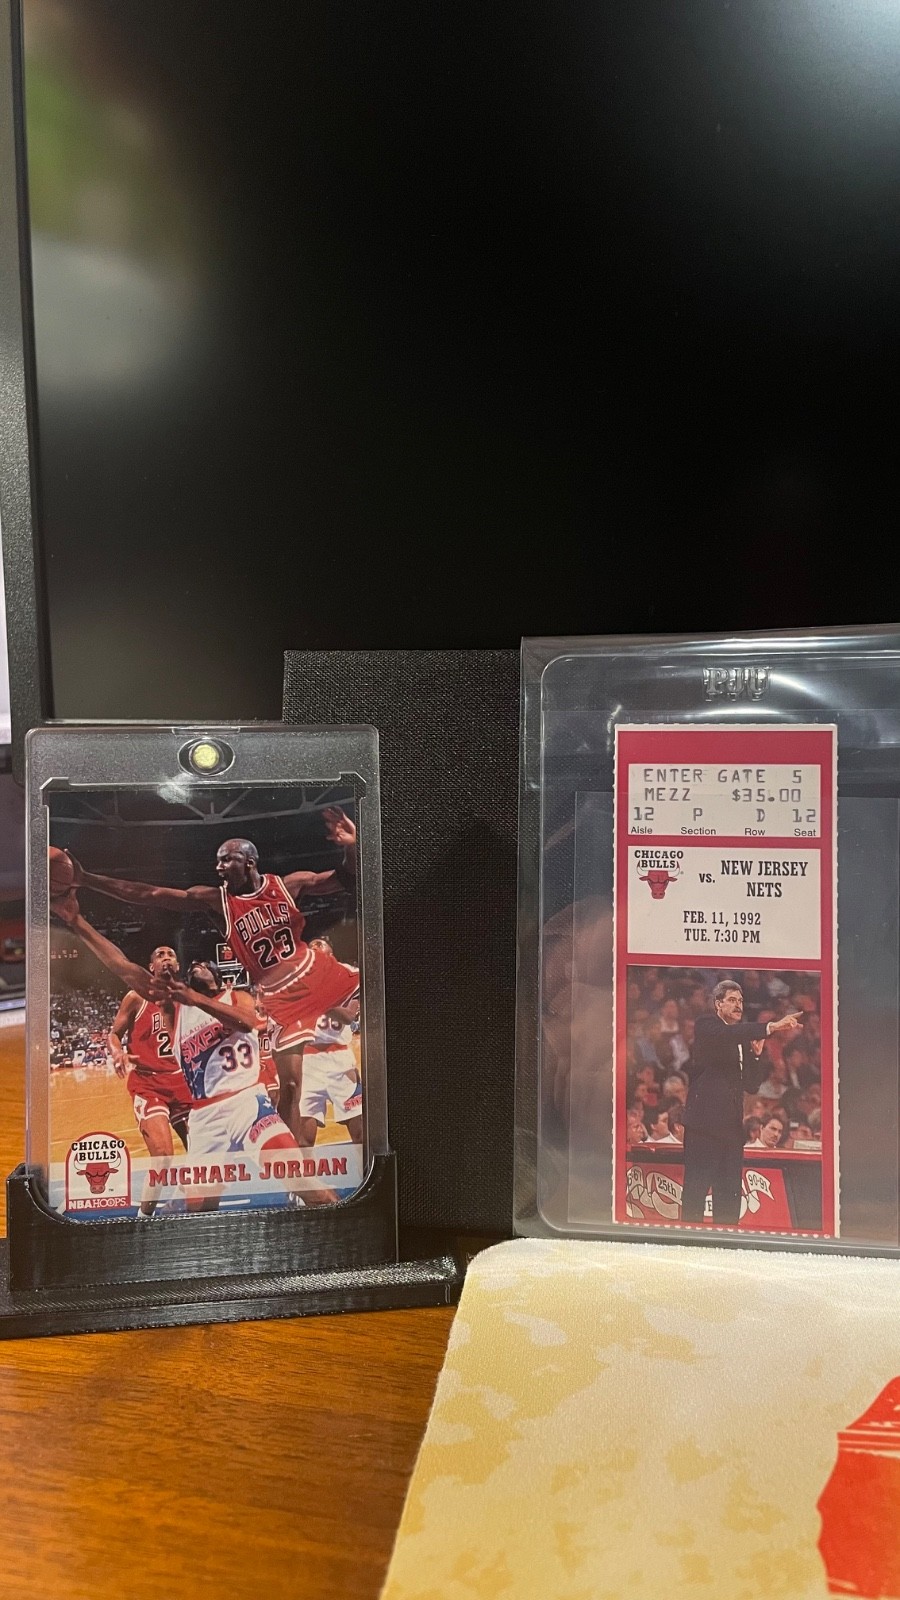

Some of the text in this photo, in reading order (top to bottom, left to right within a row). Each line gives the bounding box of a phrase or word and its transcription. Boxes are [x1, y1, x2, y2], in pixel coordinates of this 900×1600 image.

[643, 769, 802, 784] ENTER GATE 5
[644, 788, 801, 802] MEZZ $35.00
[633, 807, 816, 823] 12 P D 12
[630, 826, 816, 837] Aisle Section Row Seat
[634, 850, 684, 860] CHICAGO
[641, 859, 676, 869] BULLS
[721, 861, 756, 876] NEW
[758, 861, 808, 877] JERSEY
[746, 882, 783, 898] NETS
[234, 902, 291, 945] BULLS
[683, 911, 761, 927] FEB. 11, 1992
[684, 929, 761, 943] TUE. 7:30 PM
[251, 926, 296, 970] 23
[218, 1042, 253, 1072] 33
[71, 1140, 125, 1151] CHICAGO
[79, 1151, 116, 1161] BULLS
[149, 1157, 348, 1187] MICHAEL JORDAN
[657, 1176, 677, 1199] 25th
